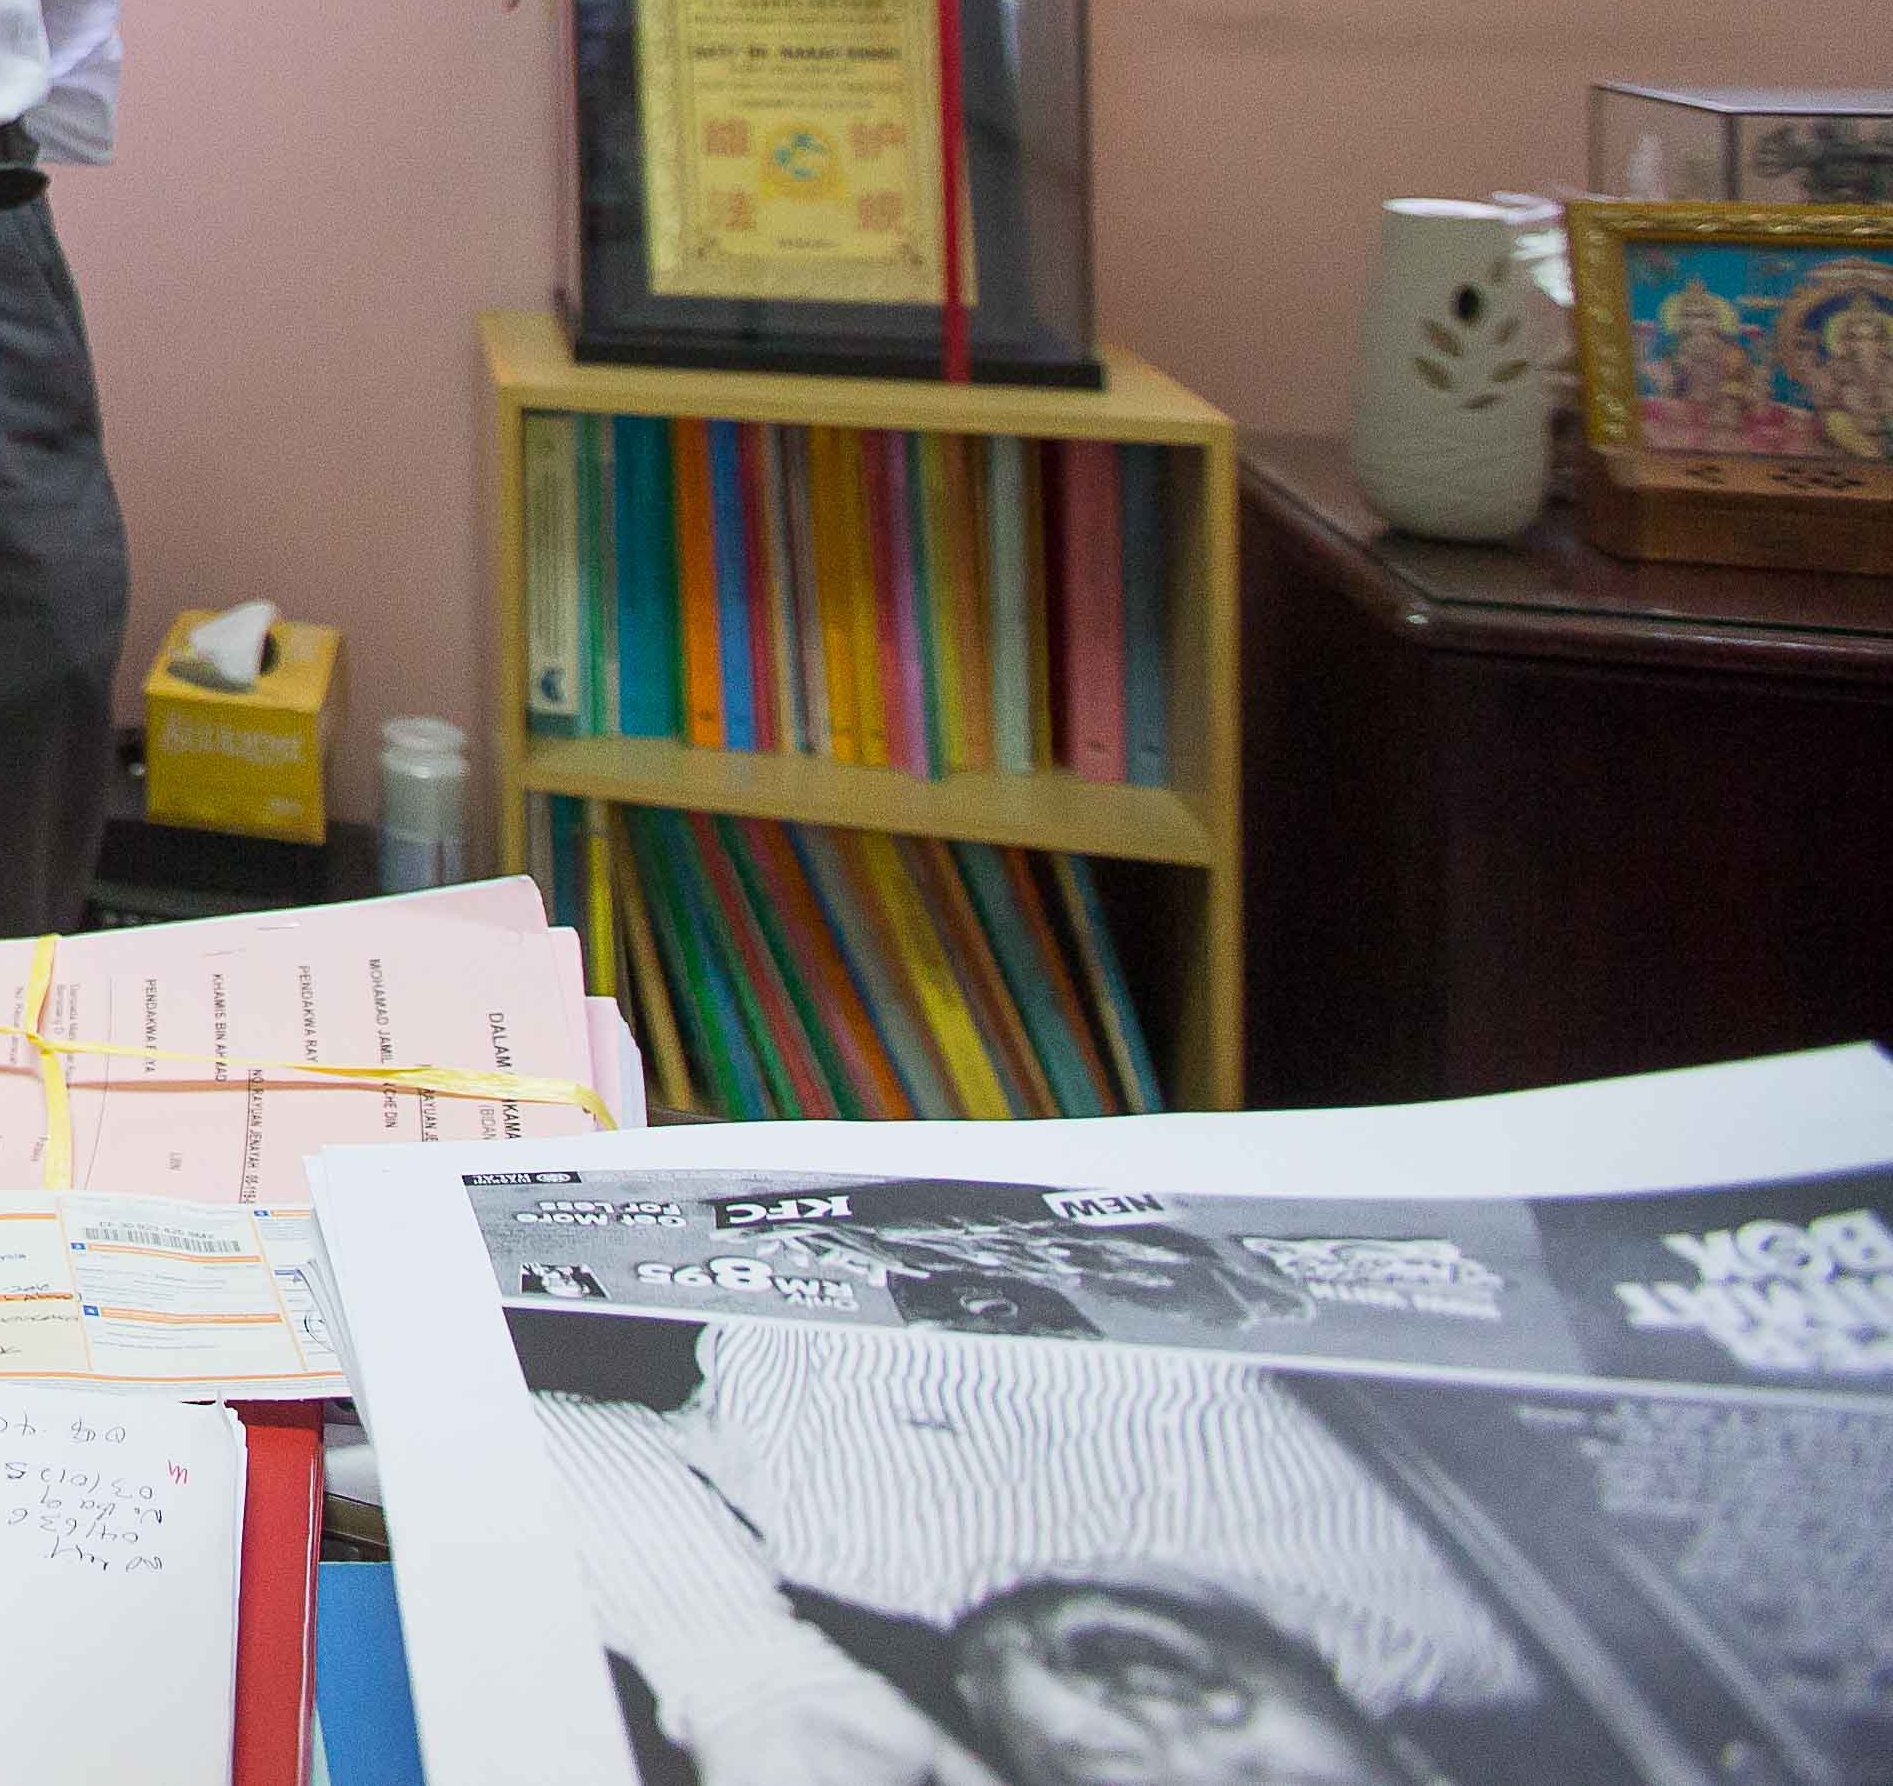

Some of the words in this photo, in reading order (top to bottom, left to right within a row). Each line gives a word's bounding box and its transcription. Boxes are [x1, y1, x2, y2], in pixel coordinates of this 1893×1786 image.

[212, 973, 228, 1020] KHAMIS
[298, 965, 317, 1036] PENDAKWA
[368, 958, 391, 1026] MOHAMAD
[143, 978, 158, 1043] PENDAKWA
[214, 1022, 228, 1042] BIN
[377, 1029, 394, 1065] JAMIL
[488, 1012, 512, 1069] DALAM
[304, 1039, 319, 1064] RAY
[250, 1087, 264, 1127] RAYUAN
[384, 1111, 399, 1129] DIN
[246, 1128, 262, 1169] JENAYAH
[514, 1212, 608, 1226] More
[537, 1201, 615, 1214] Less
[620, 1213, 687, 1229] Get
[624, 1201, 682, 1216] For
[725, 1194, 853, 1225] KFC
[1056, 1190, 1163, 1221] NEW
